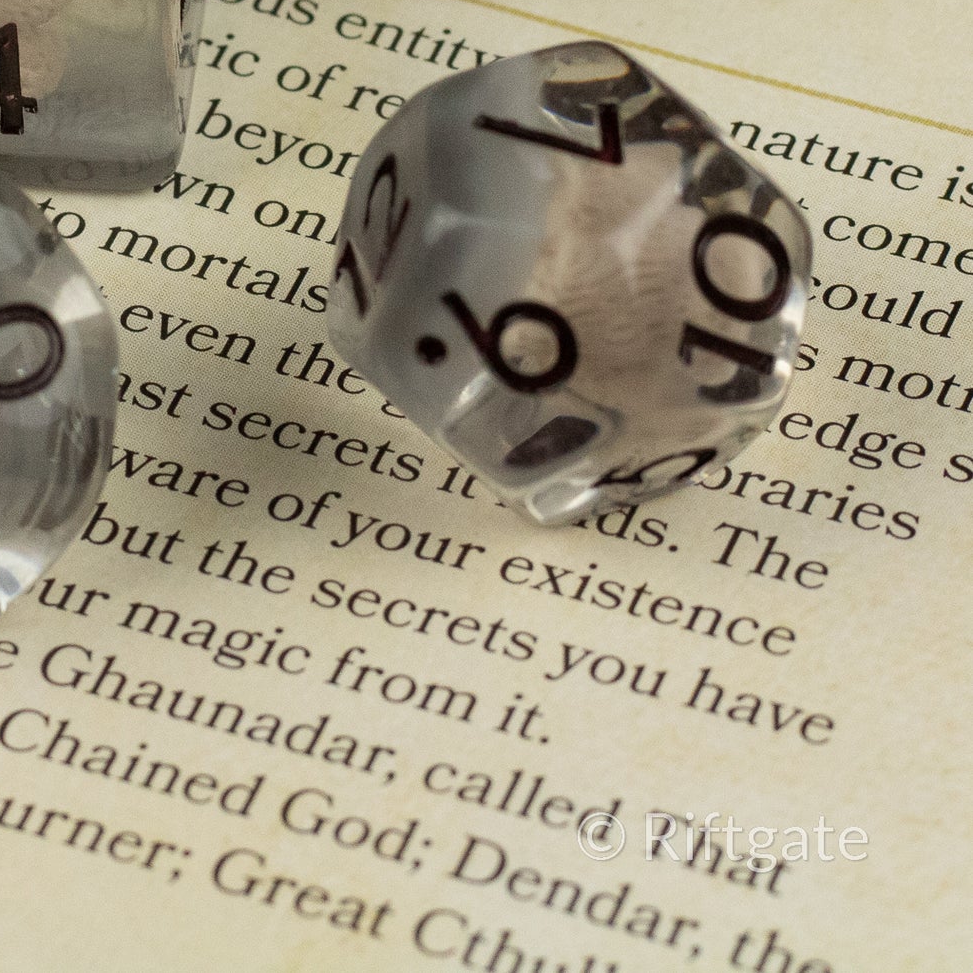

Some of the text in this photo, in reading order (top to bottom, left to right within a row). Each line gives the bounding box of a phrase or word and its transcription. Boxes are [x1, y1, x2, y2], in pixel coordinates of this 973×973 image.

[277, 64, 347, 100] of
[730, 120, 924, 192] nature
[97, 225, 327, 314] mortals
[772, 409, 927, 472] edge
[119, 302, 367, 397] even the
[677, 212, 792, 377] 10
[110, 445, 799, 659] ware of your existence
[201, 399, 427, 485] secrets
[712, 522, 829, 592] The
[80, 502, 839, 749] but the secrets you have
[119, 602, 312, 672] magic
[327, 647, 482, 725] from
[497, 692, 552, 745] it.
[39, 639, 402, 785] Ghaunadar,
[423, 759, 624, 847] called
[642, 807, 792, 897] That
[212, 844, 397, 942] Great
[279, 785, 435, 872] God;
[452, 832, 705, 962] Dendar,
